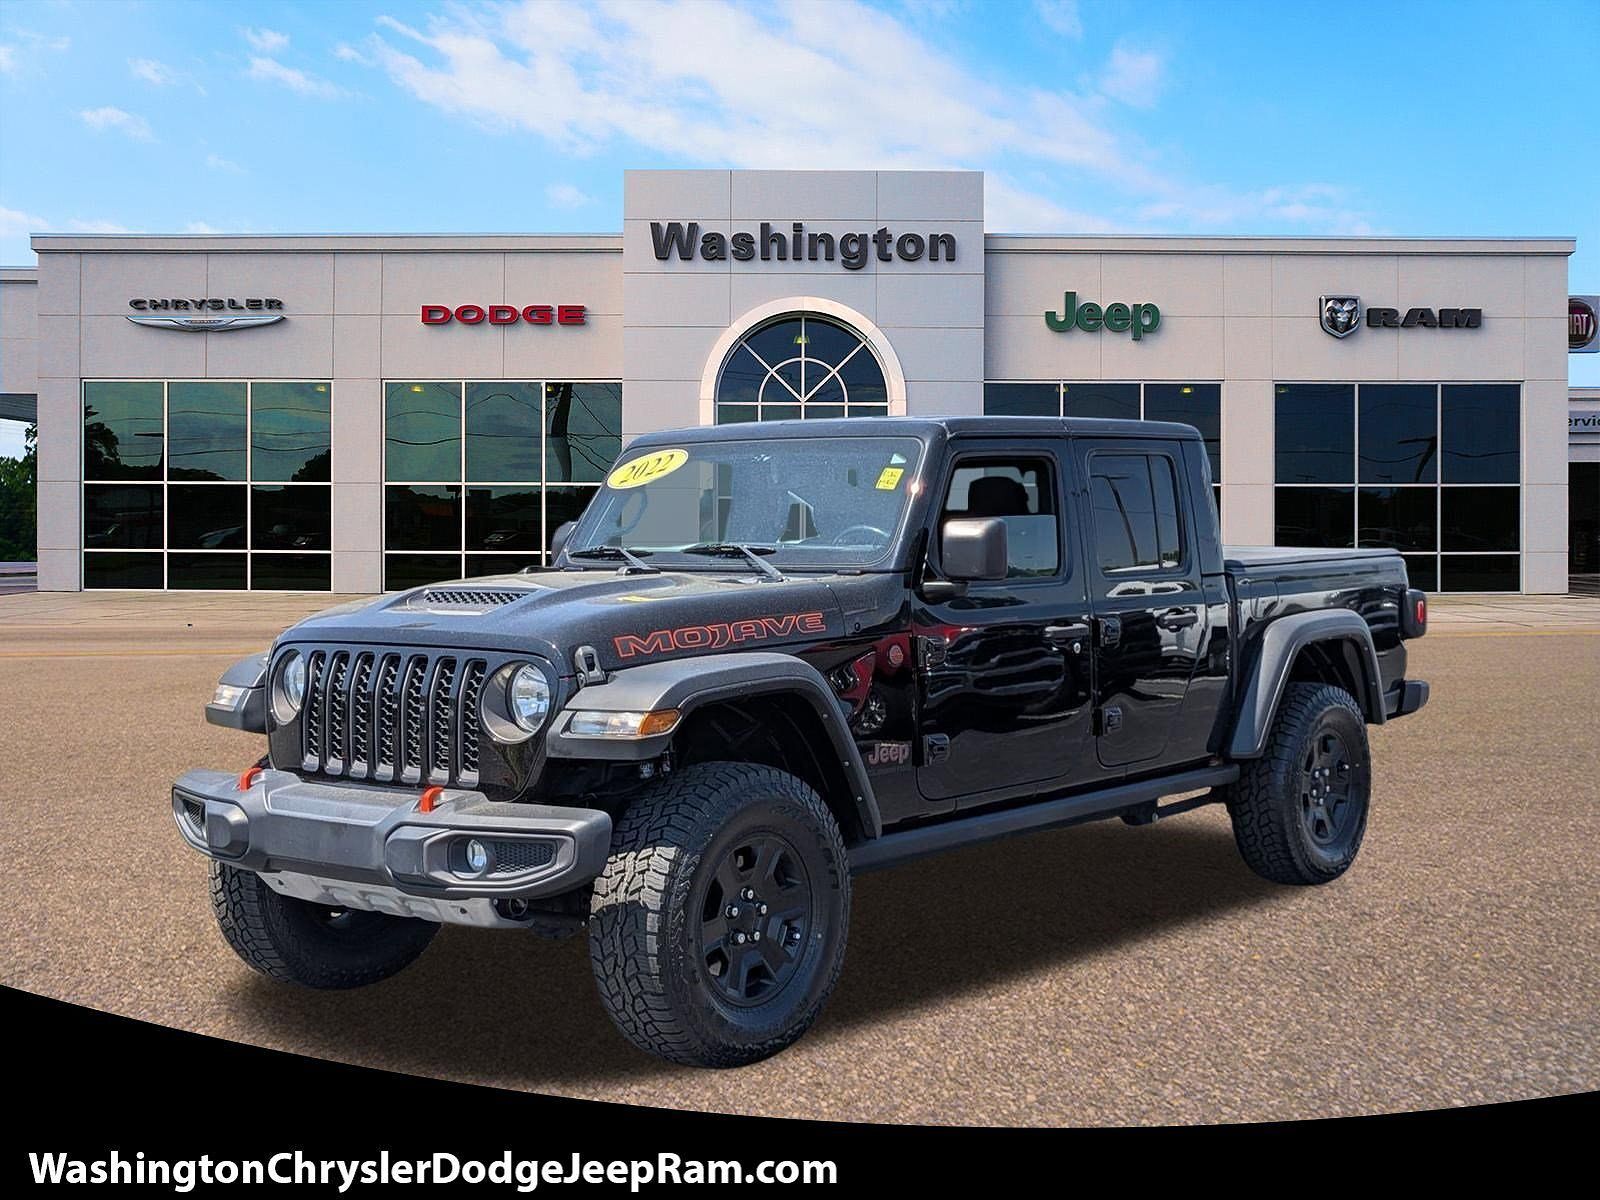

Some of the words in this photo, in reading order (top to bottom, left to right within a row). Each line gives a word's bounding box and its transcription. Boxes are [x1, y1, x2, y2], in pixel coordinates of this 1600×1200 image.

[650, 222, 957, 270] Washington
[128, 298, 283, 310] CHRYSLER
[421, 304, 587, 325] DODGE
[1045, 291, 1161, 341] Jeep
[1367, 308, 1482, 328] RAM
[1568, 314, 1589, 335] IAT
[1568, 415, 1600, 426] ervi
[619, 454, 675, 484] 2022
[612, 611, 827, 659] MOJAVE
[868, 743, 910, 764] Jeep
